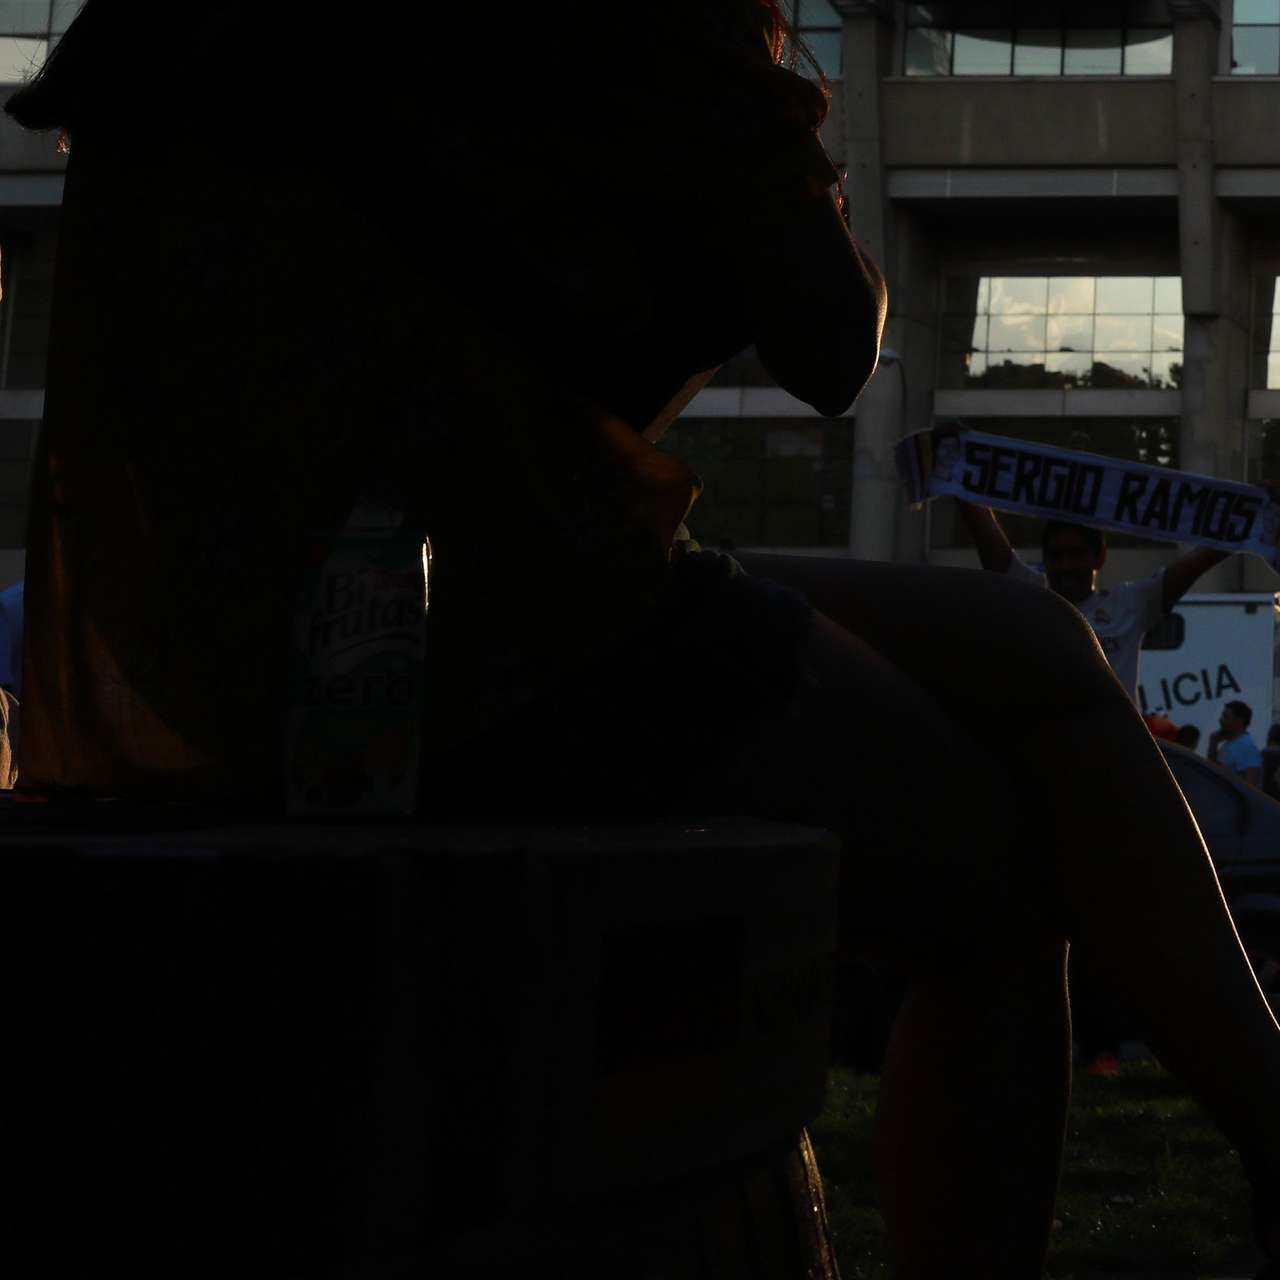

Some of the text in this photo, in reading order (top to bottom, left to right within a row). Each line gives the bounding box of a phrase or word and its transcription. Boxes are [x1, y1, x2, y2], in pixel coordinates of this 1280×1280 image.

[961, 440, 1265, 543] SERGIO RAMOS
[1138, 664, 1241, 713] LICIA
